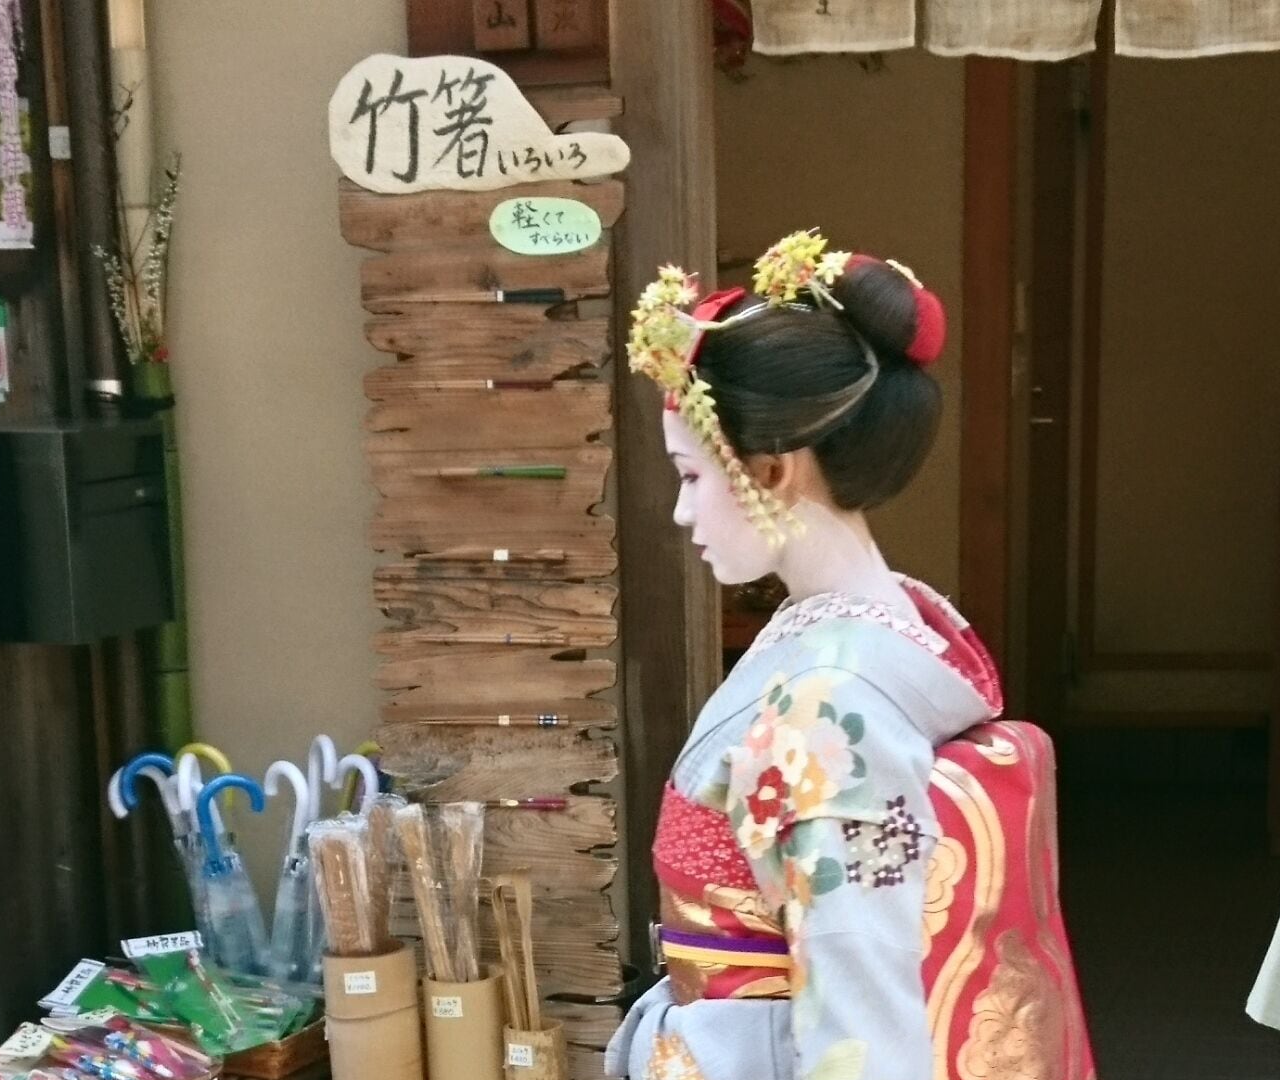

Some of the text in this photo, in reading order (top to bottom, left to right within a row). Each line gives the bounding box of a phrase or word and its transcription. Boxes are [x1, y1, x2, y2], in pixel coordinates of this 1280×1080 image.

[510, 200, 565, 229] 軽くて
[529, 231, 590, 245] すべらない
